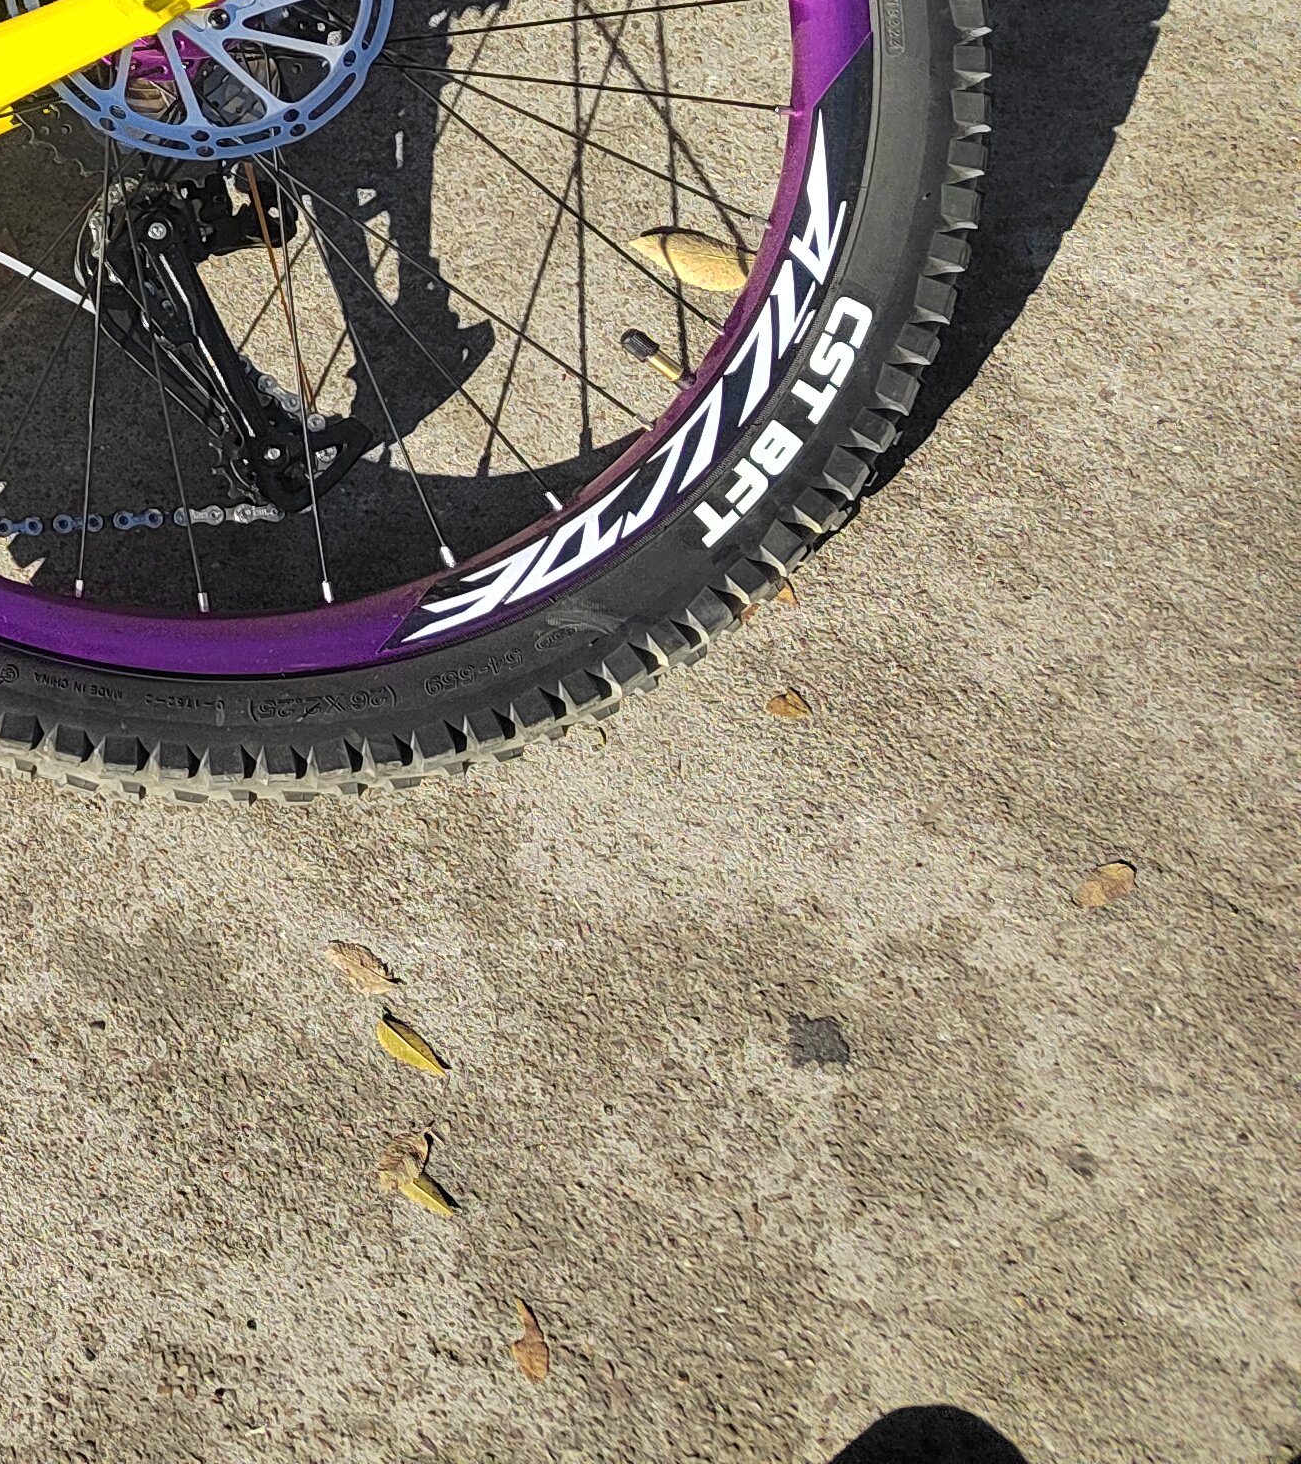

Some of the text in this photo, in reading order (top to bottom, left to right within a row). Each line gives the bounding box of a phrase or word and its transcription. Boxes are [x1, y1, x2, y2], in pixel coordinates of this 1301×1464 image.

[693, 296, 874, 549] CST BFT
[33, 671, 69, 690] CHINA
[423, 648, 523, 696] 54-559
[72, 680, 87, 695] IN
[89, 685, 124, 701] MADE
